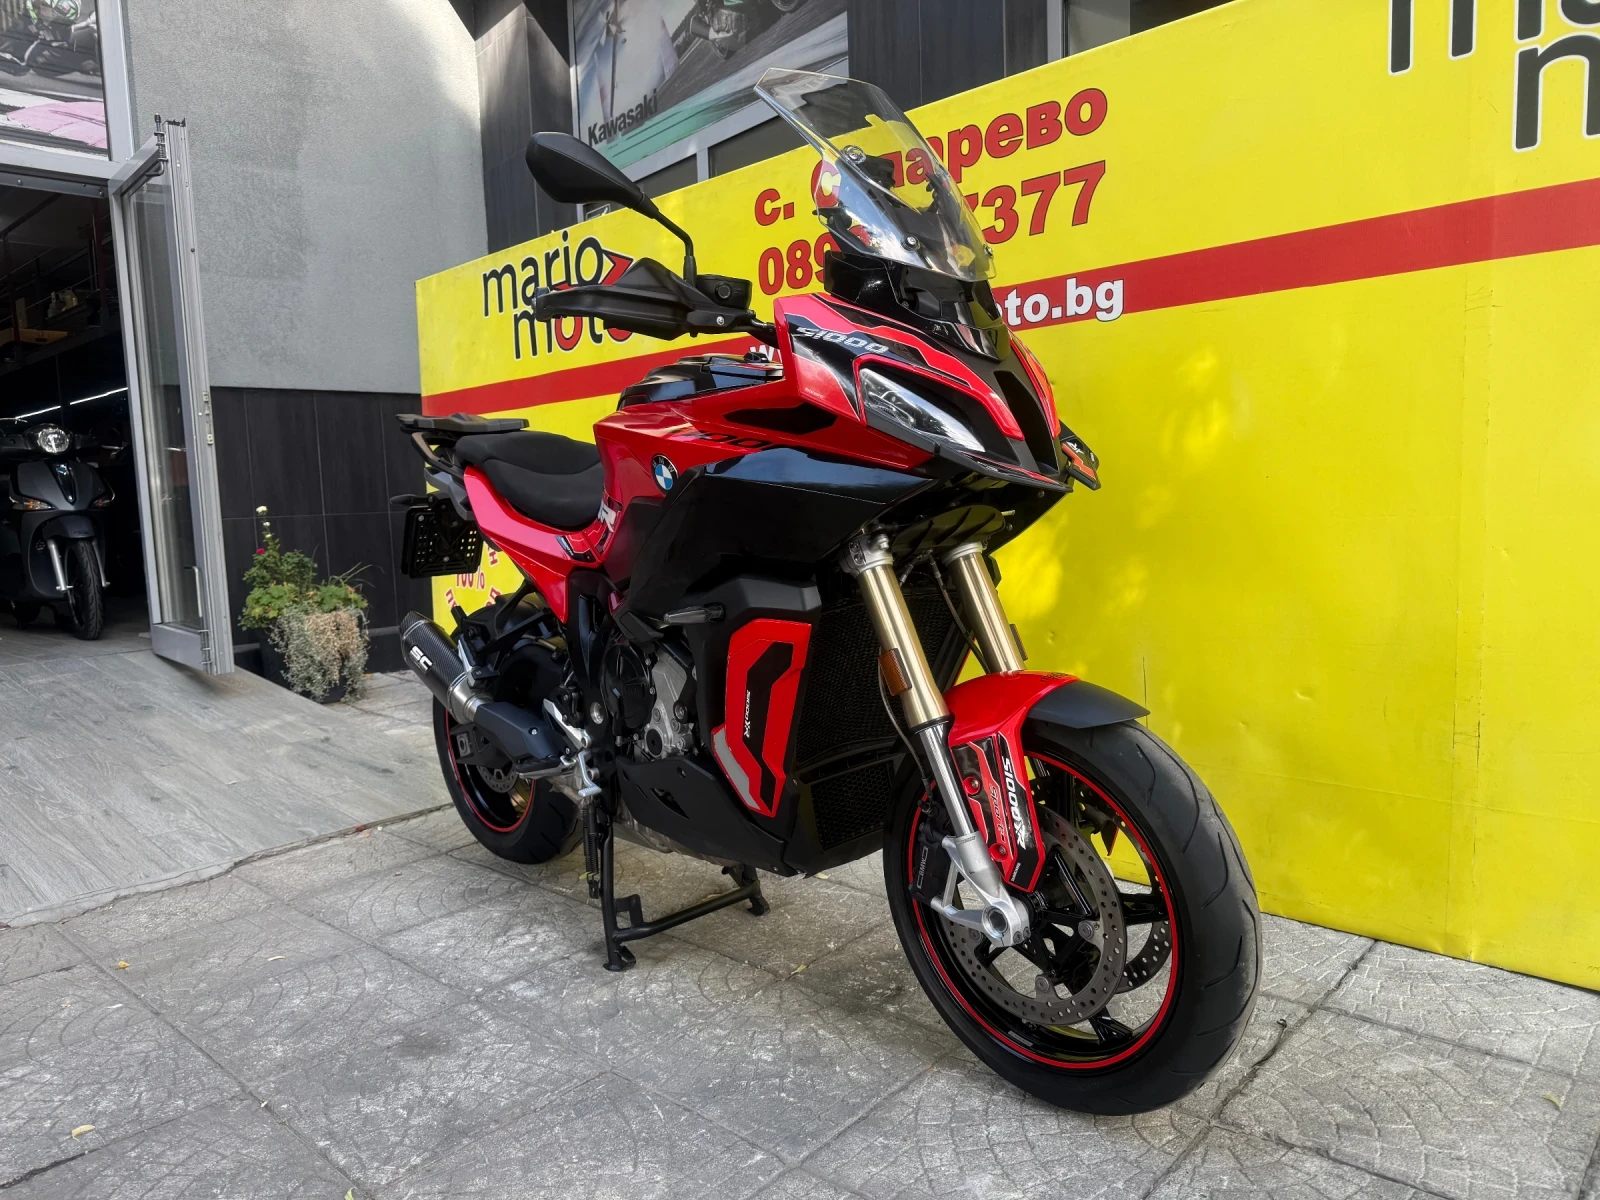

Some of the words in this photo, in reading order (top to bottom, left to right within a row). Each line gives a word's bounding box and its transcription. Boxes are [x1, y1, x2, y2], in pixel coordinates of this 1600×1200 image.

[587, 88, 658, 147] Kawasaki
[810, 87, 1109, 209] Сарево
[482, 230, 604, 317] mario
[796, 326, 890, 355] S1000
[409, 645, 434, 672] SC
[1001, 755, 1027, 851] S1000XR
[918, 858, 927, 877] BMW
